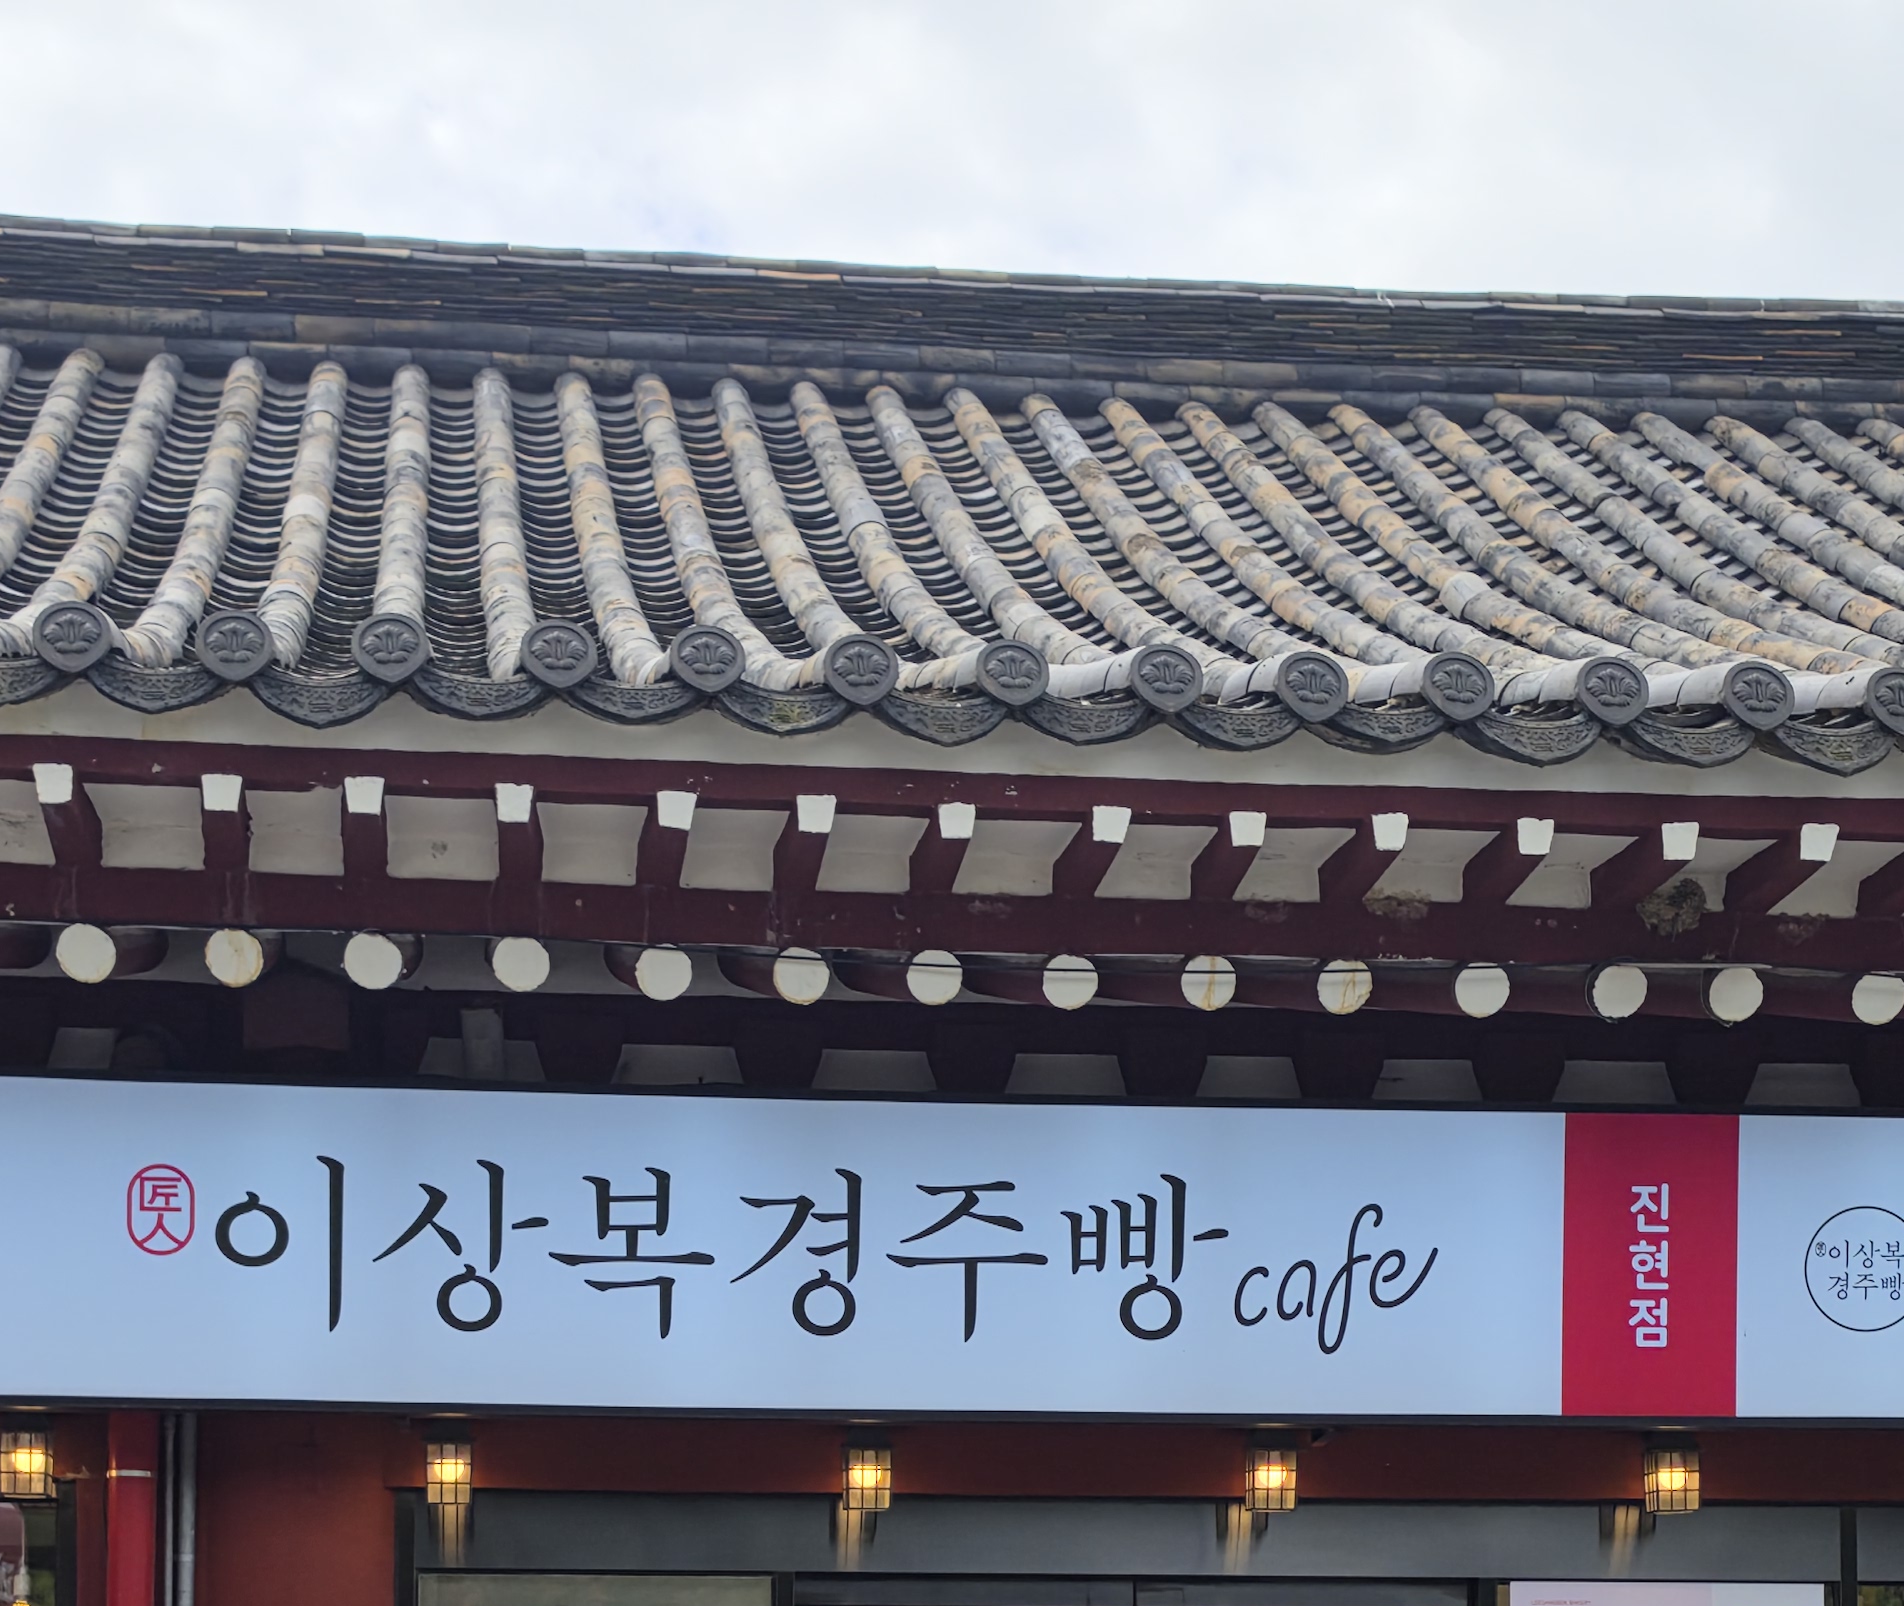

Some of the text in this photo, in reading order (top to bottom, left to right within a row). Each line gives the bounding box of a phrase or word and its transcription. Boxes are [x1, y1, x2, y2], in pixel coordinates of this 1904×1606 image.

[214, 1155, 1229, 1343] 이상복경주빵
[1234, 1203, 1439, 1355] cafe
[1629, 1183, 1670, 1349] 진현점
